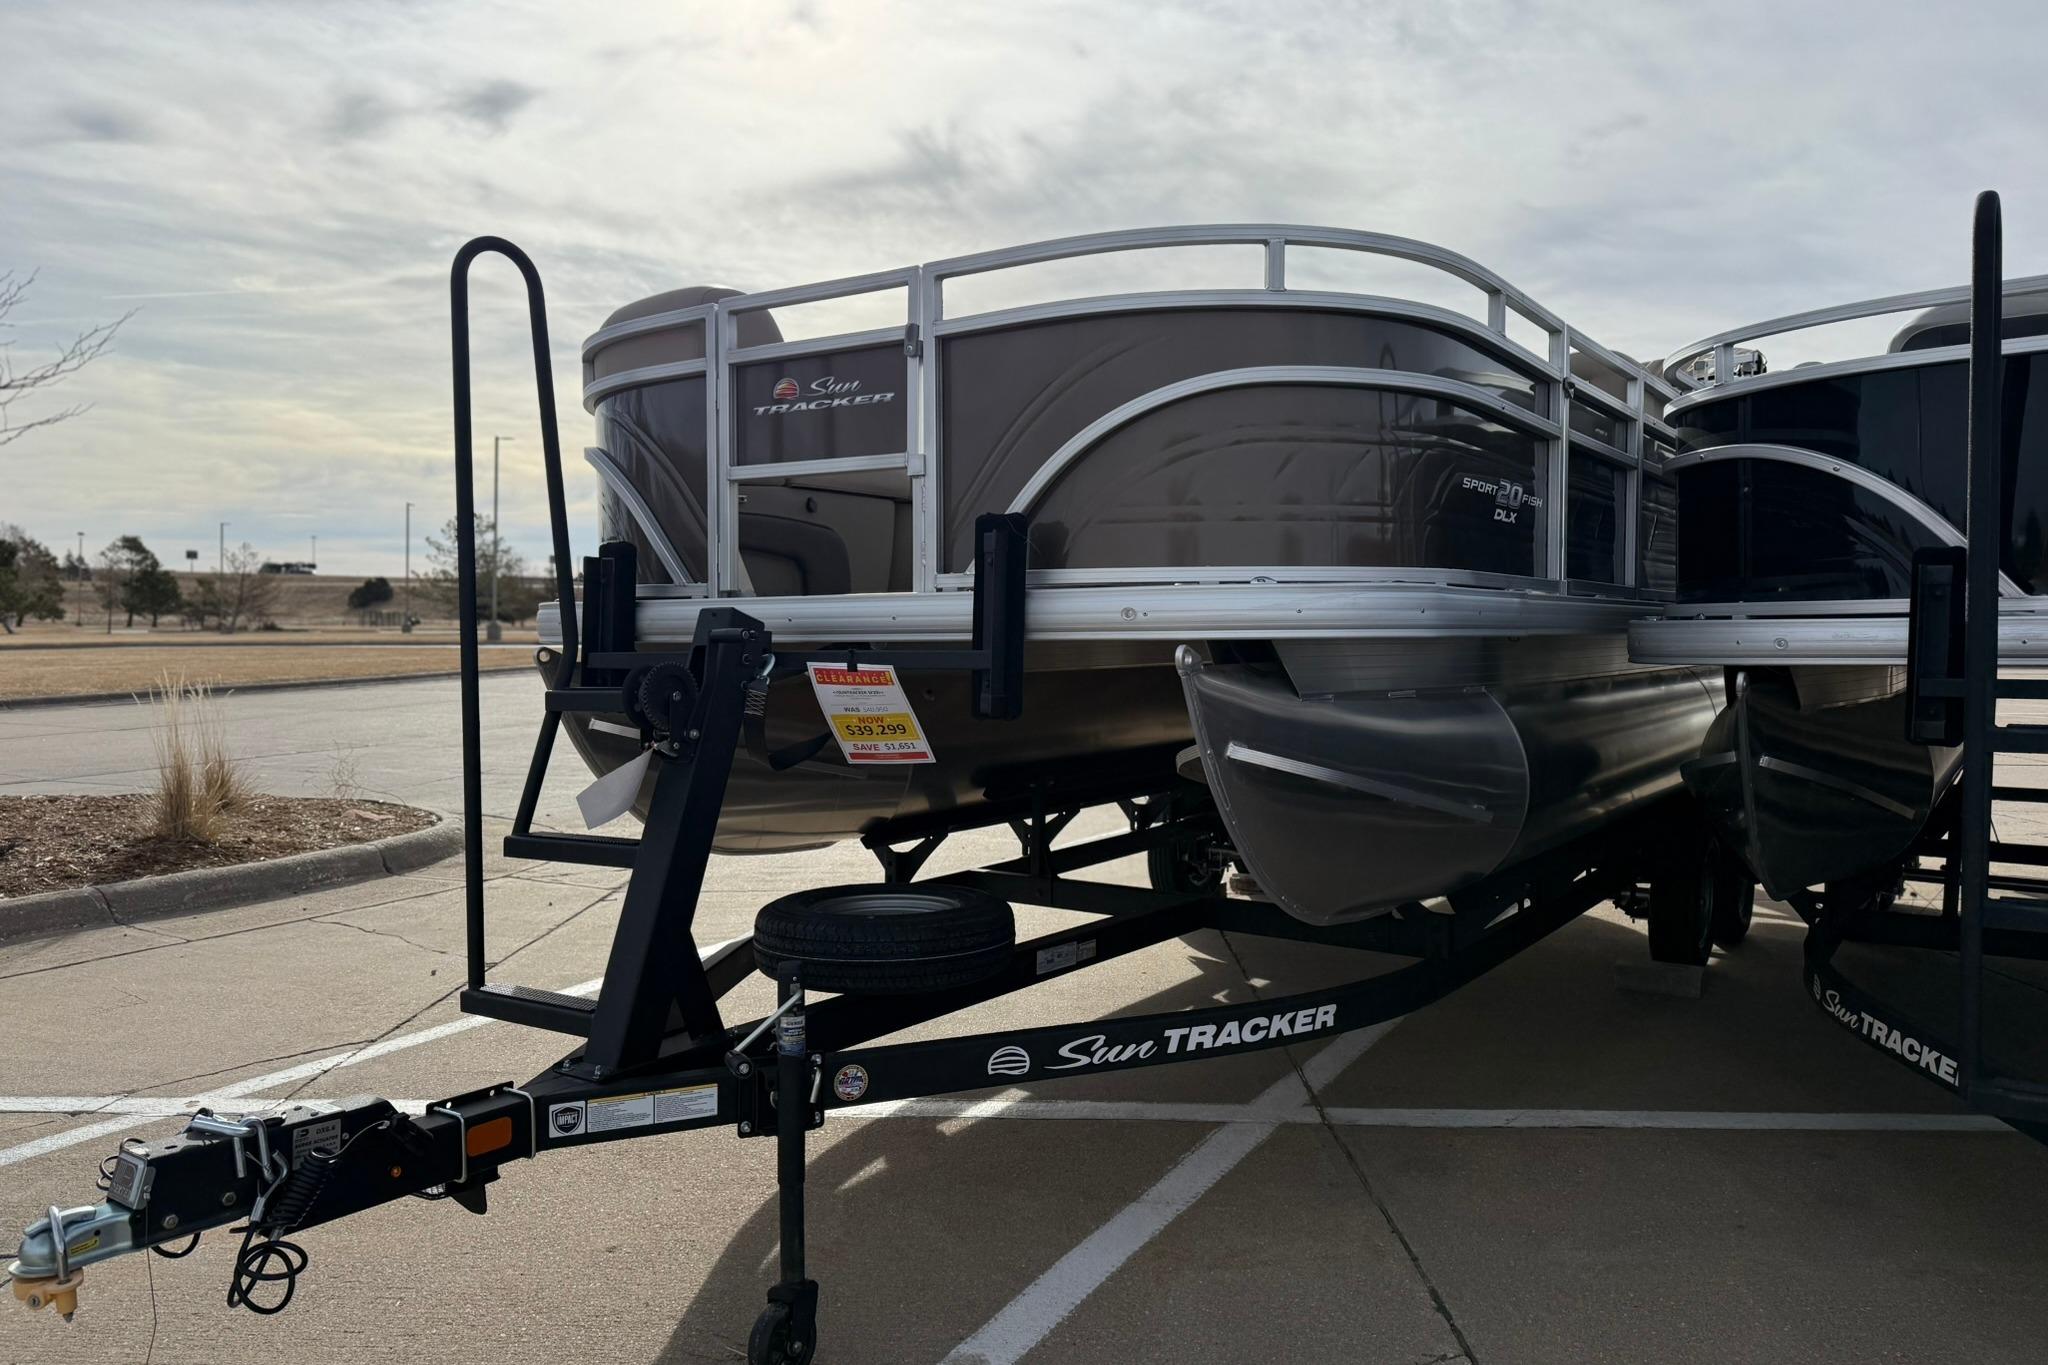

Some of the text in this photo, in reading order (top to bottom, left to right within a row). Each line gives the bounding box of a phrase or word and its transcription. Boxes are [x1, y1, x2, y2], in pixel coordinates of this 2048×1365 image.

[801, 376, 862, 397] Sun
[753, 392, 896, 416] TRACKER
[1462, 477, 1543, 509] SPORT 20 FISH
[1494, 508, 1518, 524] DLX
[857, 716, 884, 725] NOW
[852, 742, 916, 751] SAVE $1,651
[1043, 1003, 1337, 1070] Sun TRACKER
[1822, 989, 1959, 1087] Sun TRACKE
